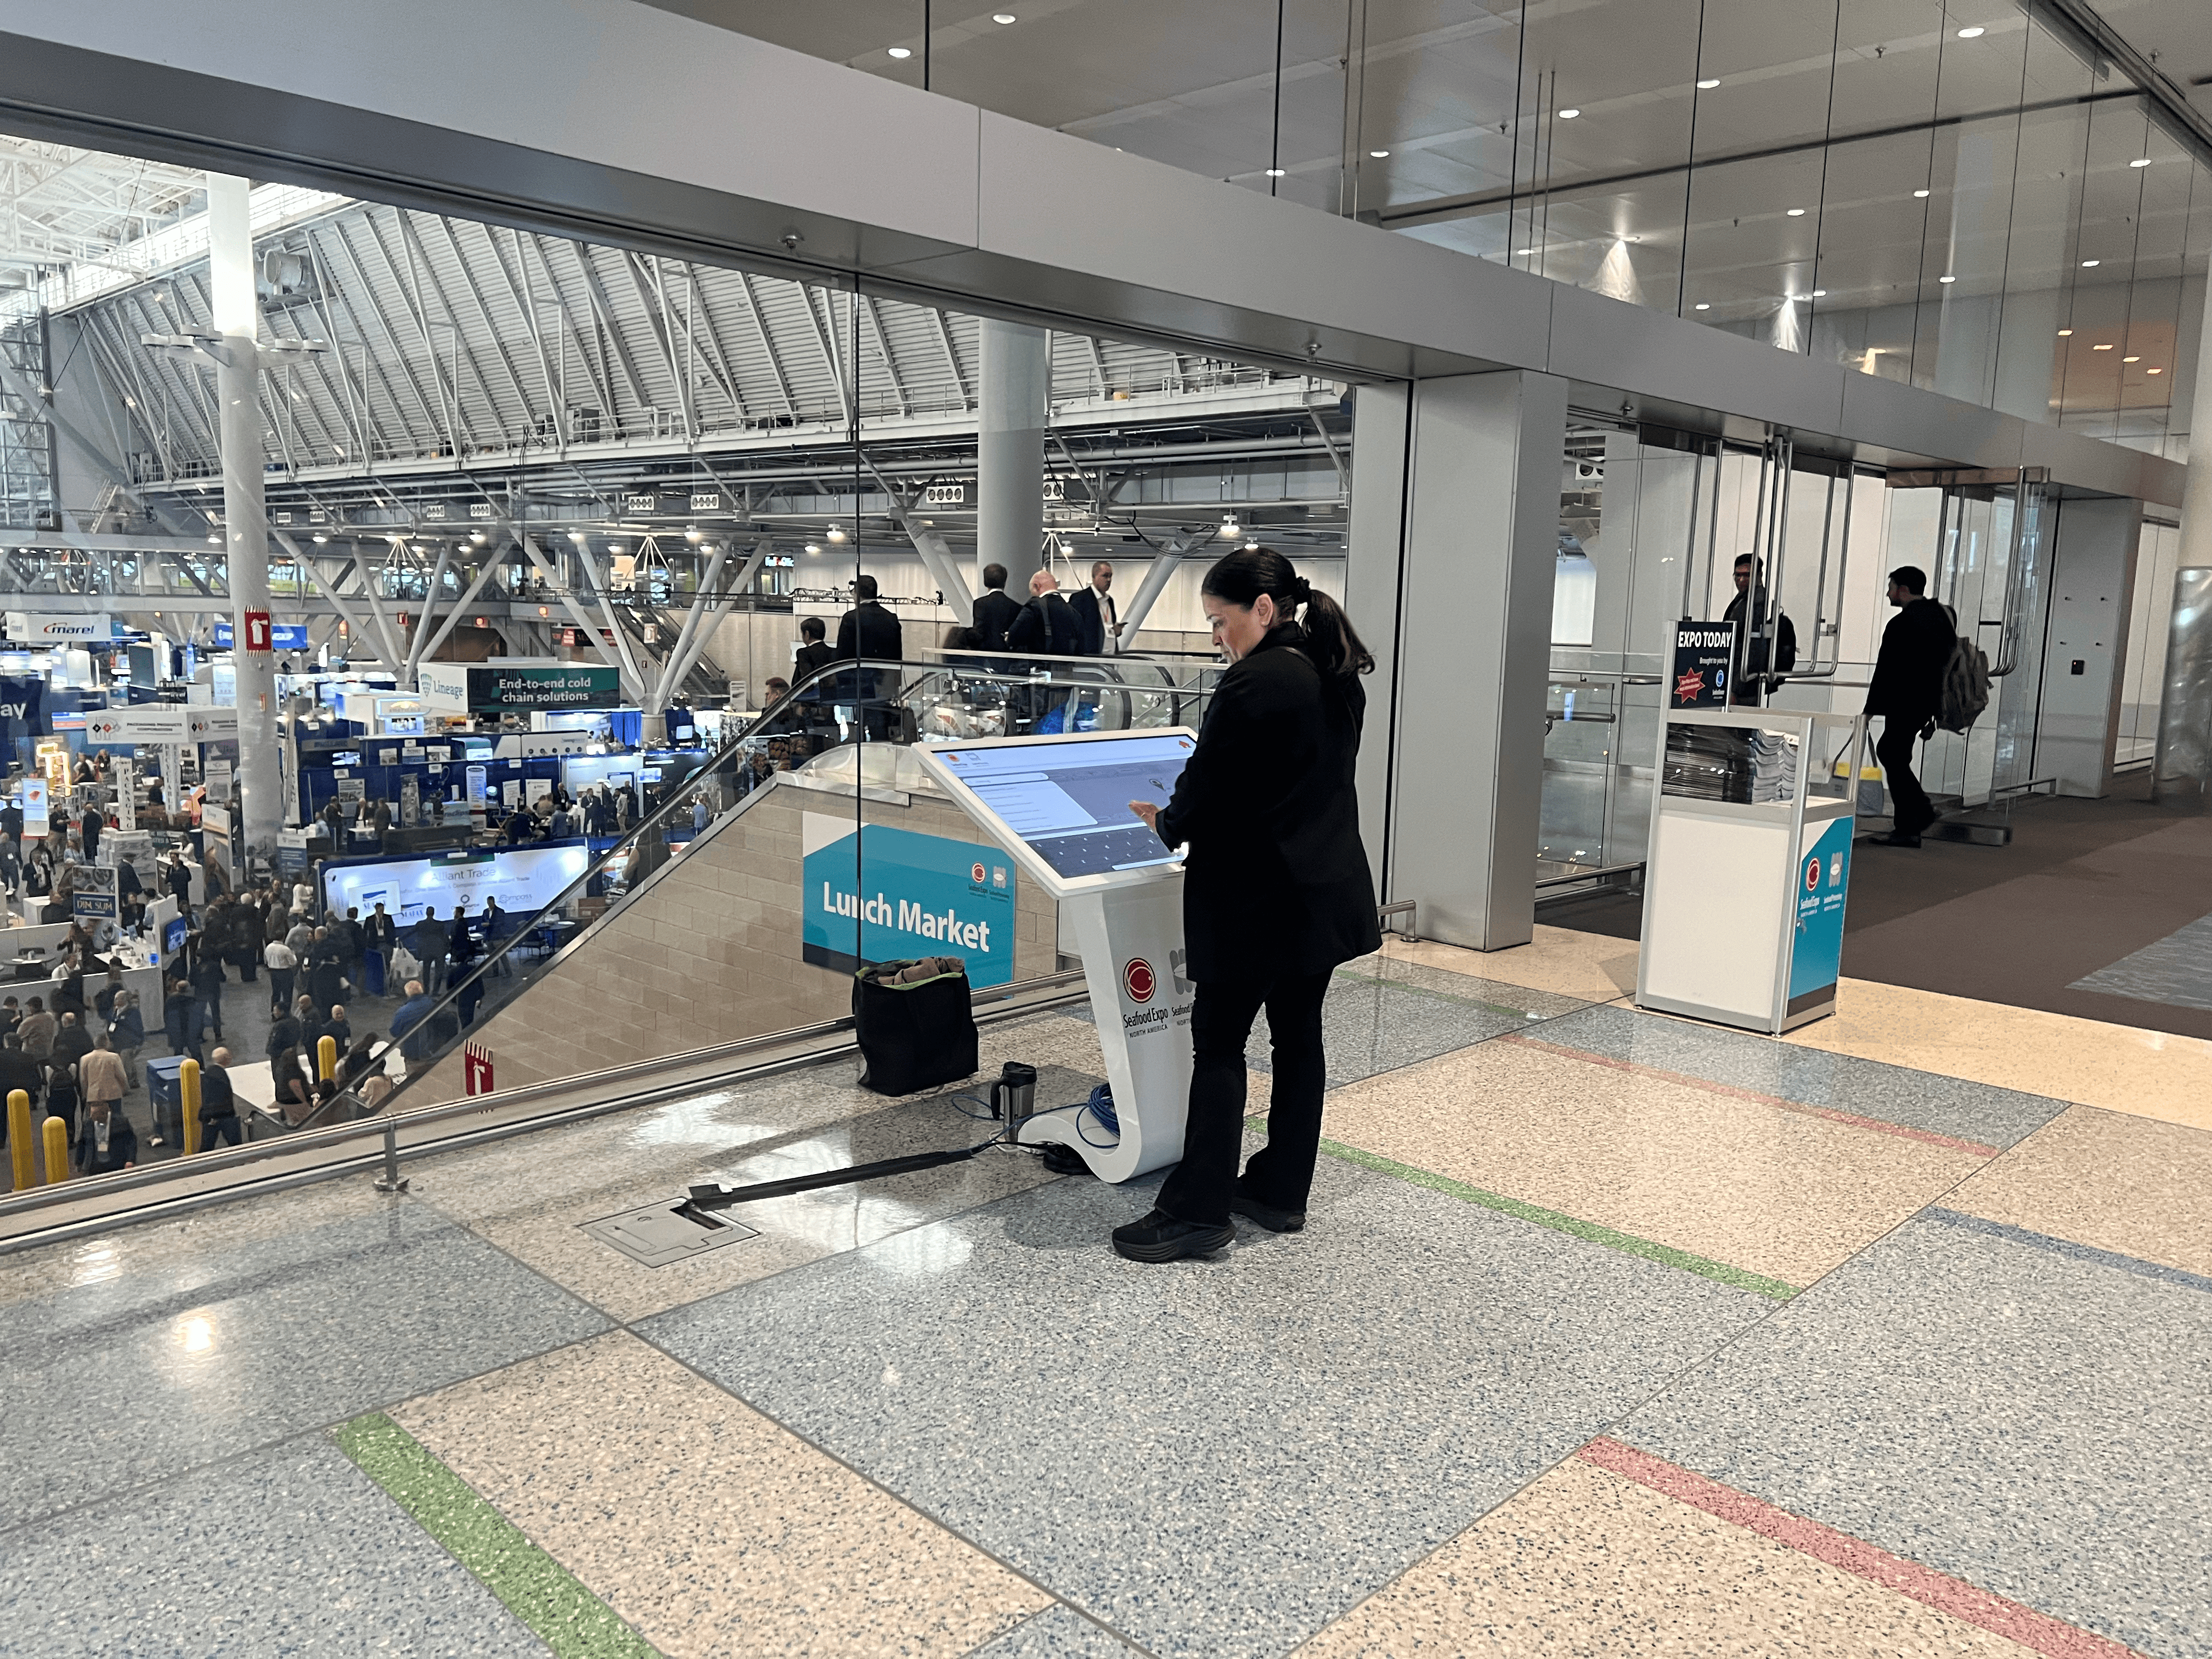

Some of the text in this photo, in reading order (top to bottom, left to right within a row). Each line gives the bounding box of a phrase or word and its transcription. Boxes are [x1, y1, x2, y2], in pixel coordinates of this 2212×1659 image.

[52, 625, 94, 634] marel
[1678, 631, 1732, 648] EXPO TODAY
[433, 680, 464, 699] Lineage
[499, 677, 591, 689] End-to-end cold
[502, 691, 589, 702] chain solutions
[124, 768, 133, 828] PACKAGING
[467, 867, 496, 878] Trade
[823, 881, 990, 952] Lunch Market
[1171, 1003, 1190, 1017] Seafood
[1123, 1007, 1169, 1029] Seafood Expo
[1129, 1024, 1168, 1039] NORTH AMERICA
